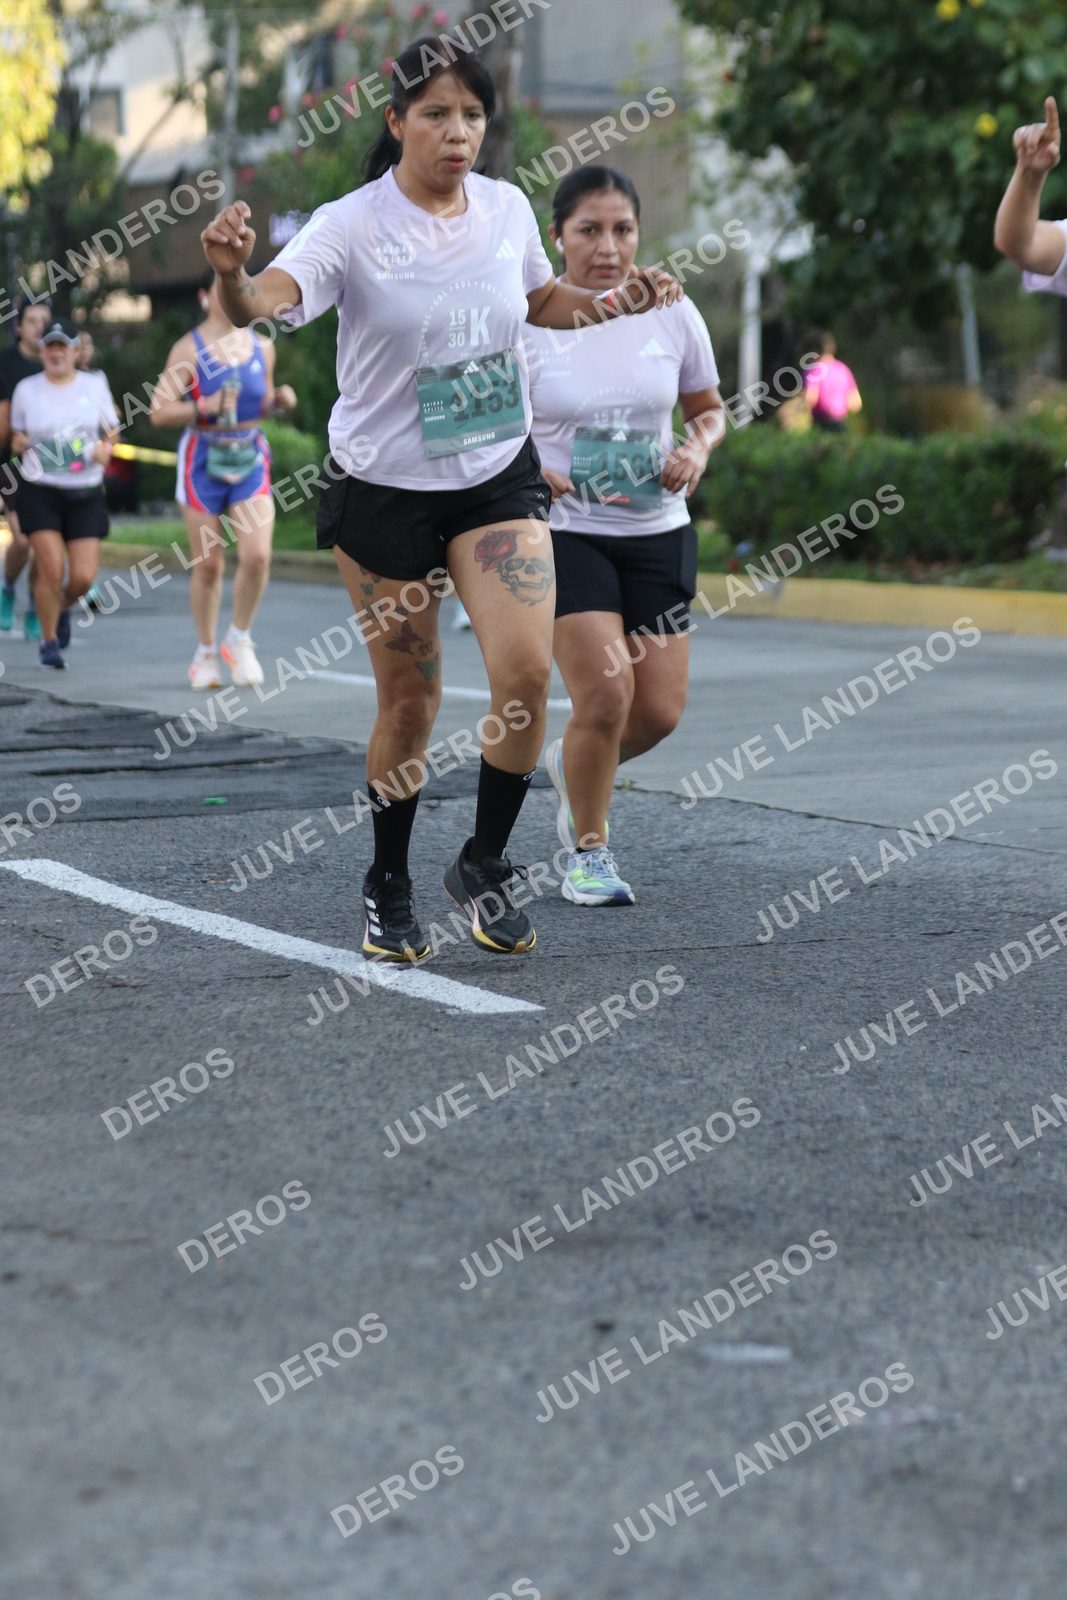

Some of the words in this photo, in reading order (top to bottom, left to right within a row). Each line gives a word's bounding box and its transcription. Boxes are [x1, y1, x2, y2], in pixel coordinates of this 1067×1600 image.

[449, 308, 466, 327] 15
[470, 306, 491, 347] K
[448, 331, 465, 348] 30
[463, 431, 496, 446] SAMSUNG
